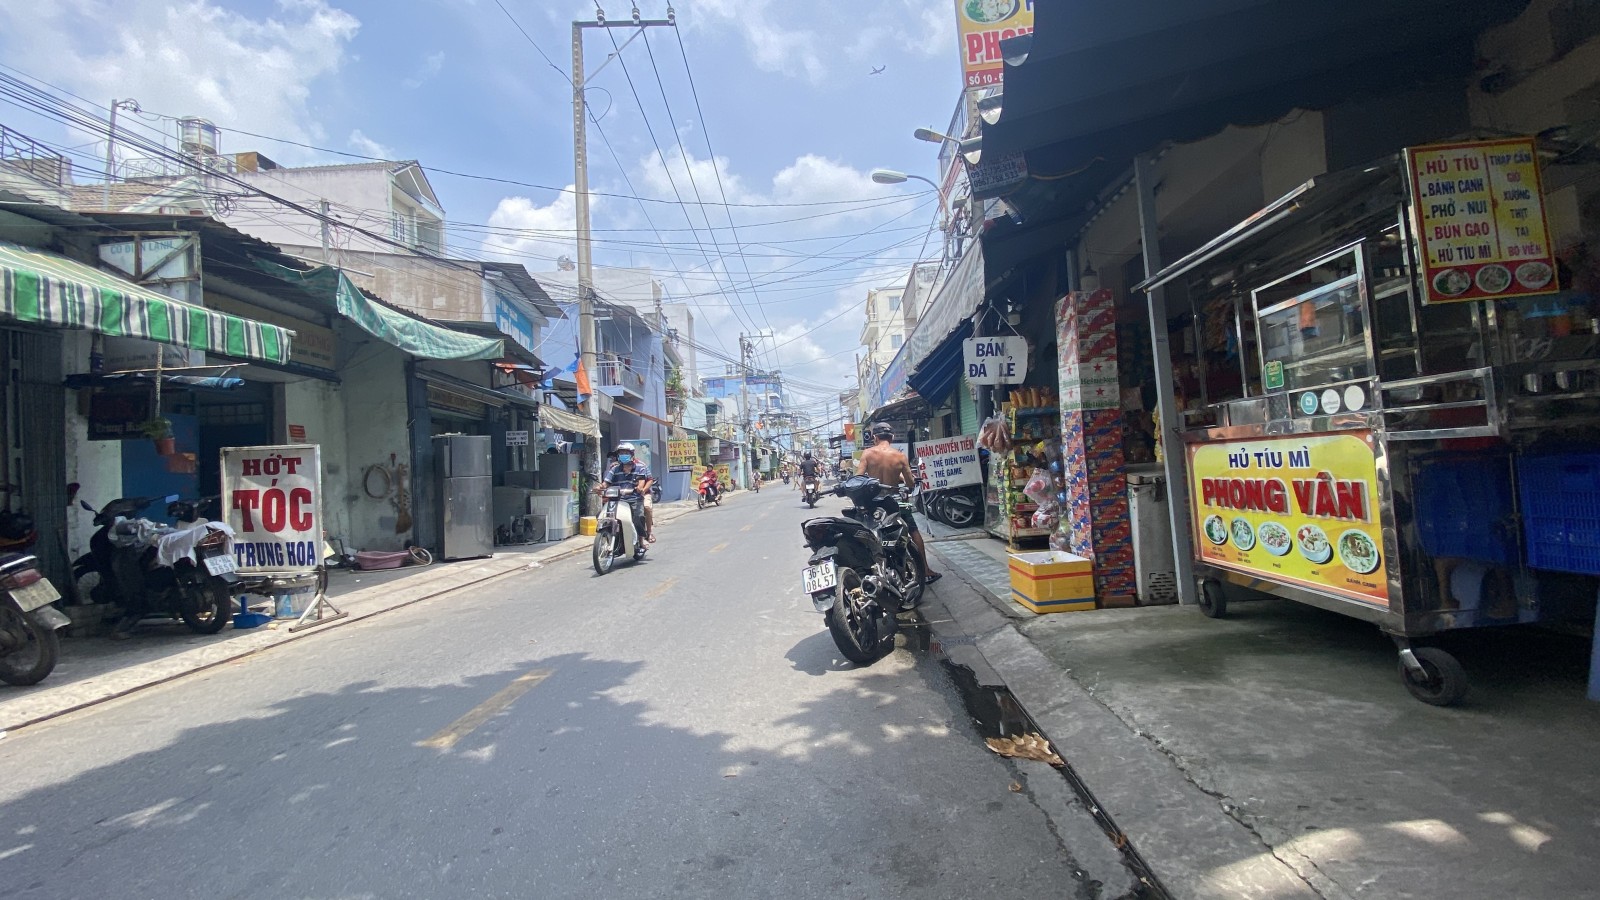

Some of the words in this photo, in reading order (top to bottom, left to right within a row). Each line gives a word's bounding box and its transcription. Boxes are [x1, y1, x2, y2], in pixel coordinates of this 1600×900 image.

[969, 72, 981, 85] SỐ
[983, 74, 992, 84] 10
[1426, 154, 1448, 174] HỦ
[1453, 154, 1479, 171] TÍU
[1428, 178, 1455, 196] BÁNH
[1458, 178, 1484, 194] CANH
[1431, 198, 1456, 219] PHỞ
[1467, 200, 1487, 215] NUI
[1434, 222, 1461, 240] BÚN
[1465, 222, 1489, 239] GẠO
[1438, 243, 1453, 262] HỦ
[1456, 243, 1475, 261] TÍU
[1478, 241, 1491, 259] MÌ
[976, 339, 1005, 358] BÁN
[969, 359, 987, 378] ĐÁ
[999, 356, 1016, 377] LẺ
[242, 453, 302, 476] HỚT
[1229, 448, 1249, 468] HỦ
[1254, 448, 1283, 468] TÍU
[1289, 446, 1310, 467] MÌ
[946, 467, 963, 477] GAME
[232, 479, 313, 533] TÓC
[1202, 478, 1291, 515] PHONG
[1292, 471, 1370, 523] VÂN
[234, 542, 284, 567] TRUNG
[286, 541, 316, 566] HOA
[806, 574, 834, 592] 084.57
